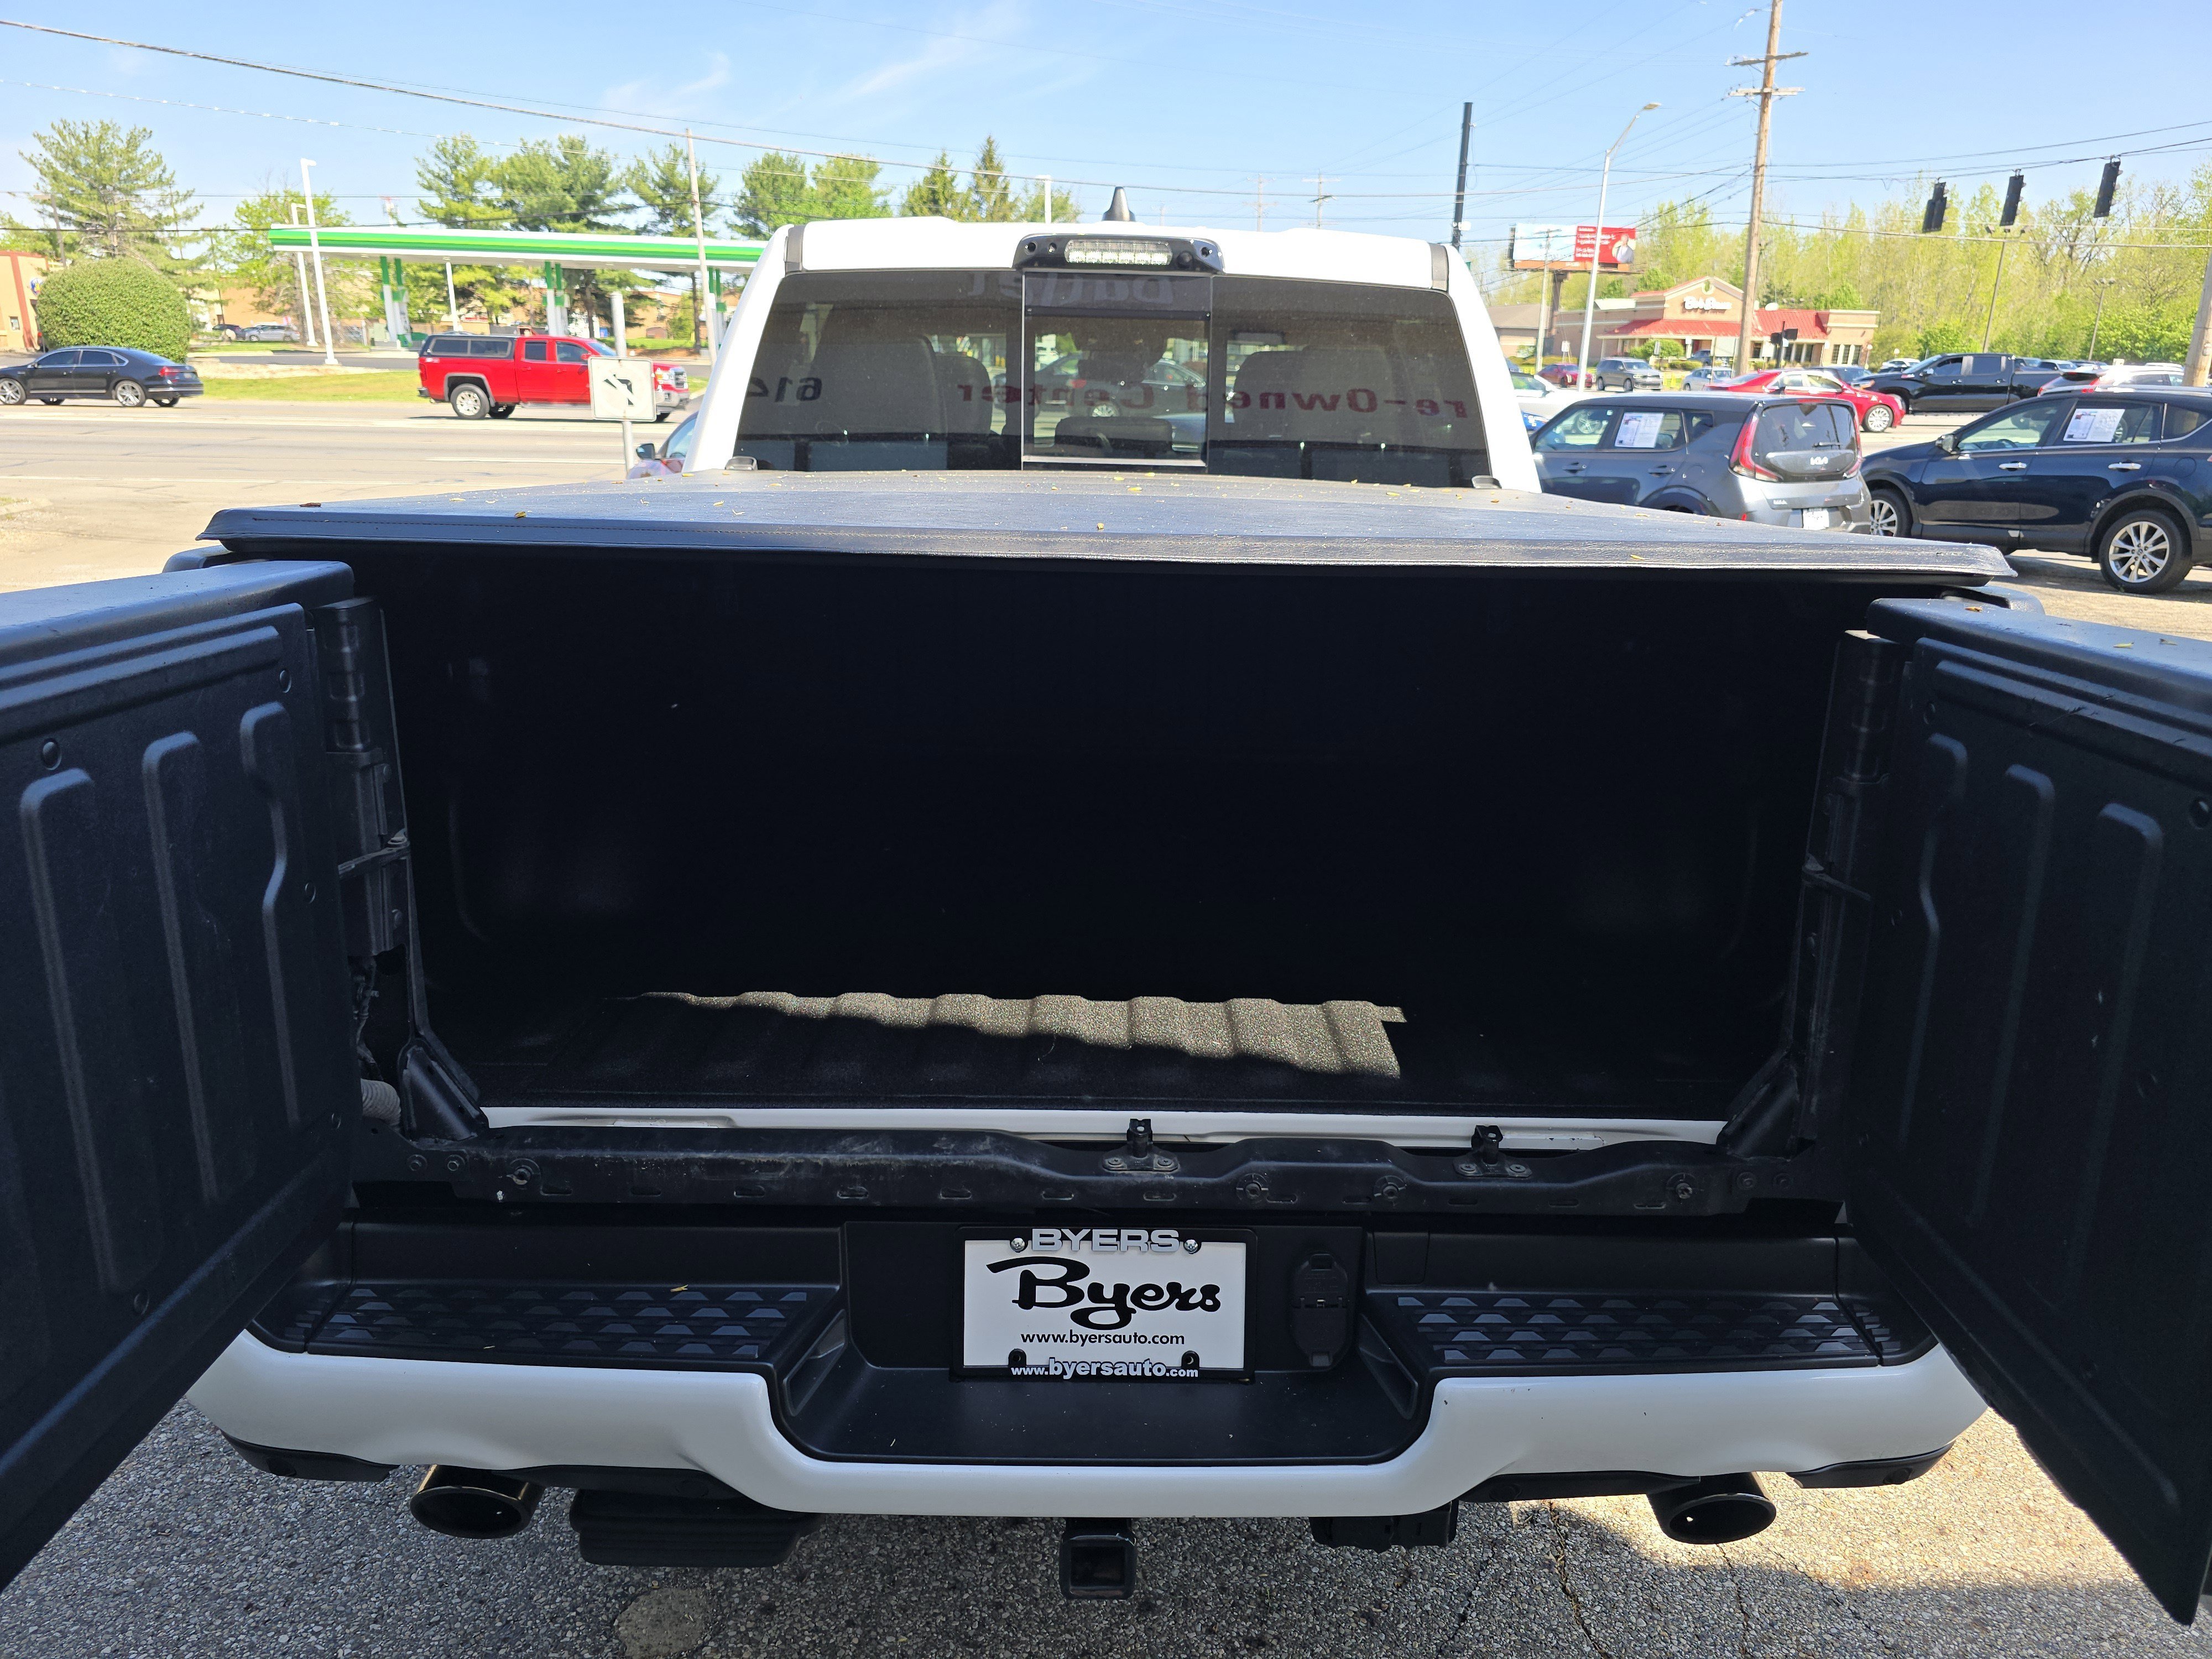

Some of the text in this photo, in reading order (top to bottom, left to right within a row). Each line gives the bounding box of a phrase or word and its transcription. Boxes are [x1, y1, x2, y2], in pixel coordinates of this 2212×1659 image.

[1032, 1228, 1180, 1253] BYERS
[986, 1256, 1222, 1330] Byers
[1021, 1329, 1185, 1347] www.byersauto.com
[1011, 1357, 1199, 1379] www.byersauto.com
